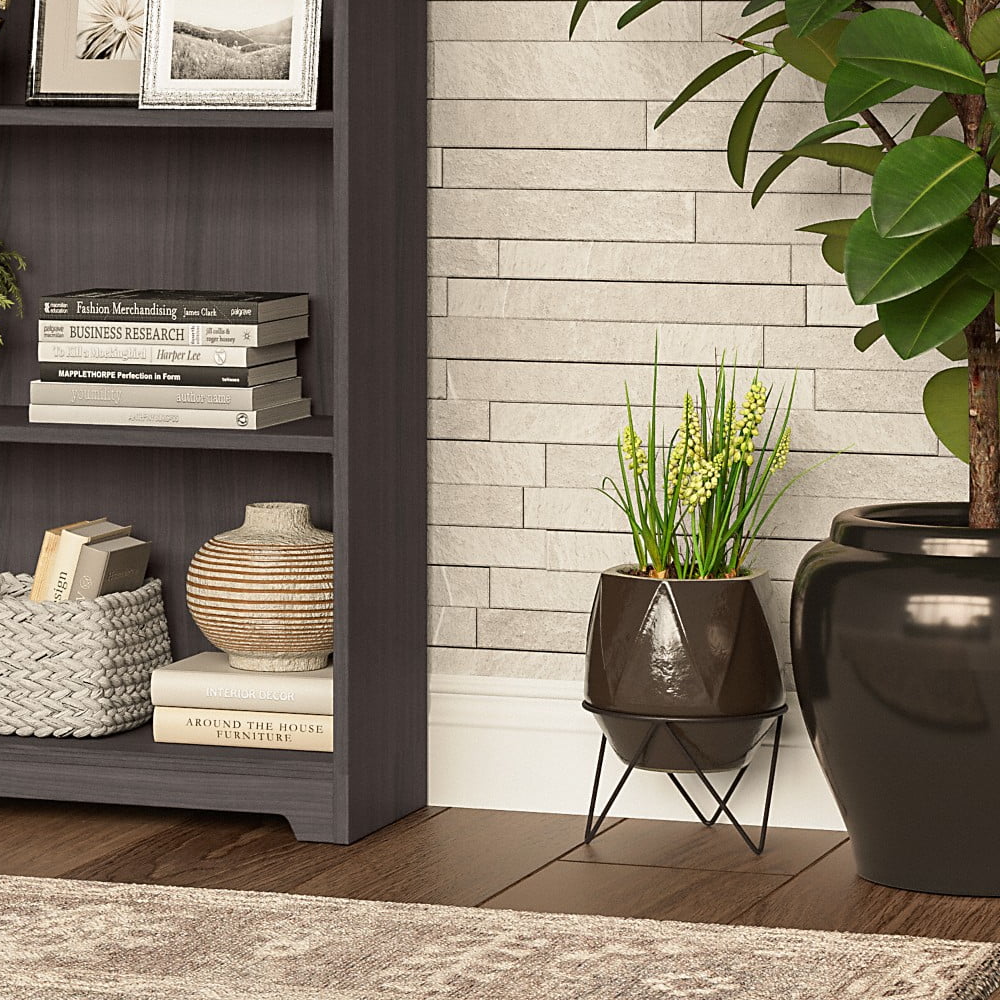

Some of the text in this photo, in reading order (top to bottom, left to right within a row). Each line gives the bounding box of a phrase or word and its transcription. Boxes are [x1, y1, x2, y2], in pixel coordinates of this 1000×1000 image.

[76, 300, 218, 320] Fashion Merchandising James Clark
[69, 325, 185, 341] BUSINESS RESEARCH
[156, 348, 202, 362] Harper Lee
[58, 369, 181, 381] MAPPLETHORPE Perfection in Form
[53, 571, 68, 602] sign
[205, 686, 296, 702] INTERIOR DECOR
[185, 717, 324, 734] AROUND THE HOUSE
[216, 729, 293, 744] FURNITURE
